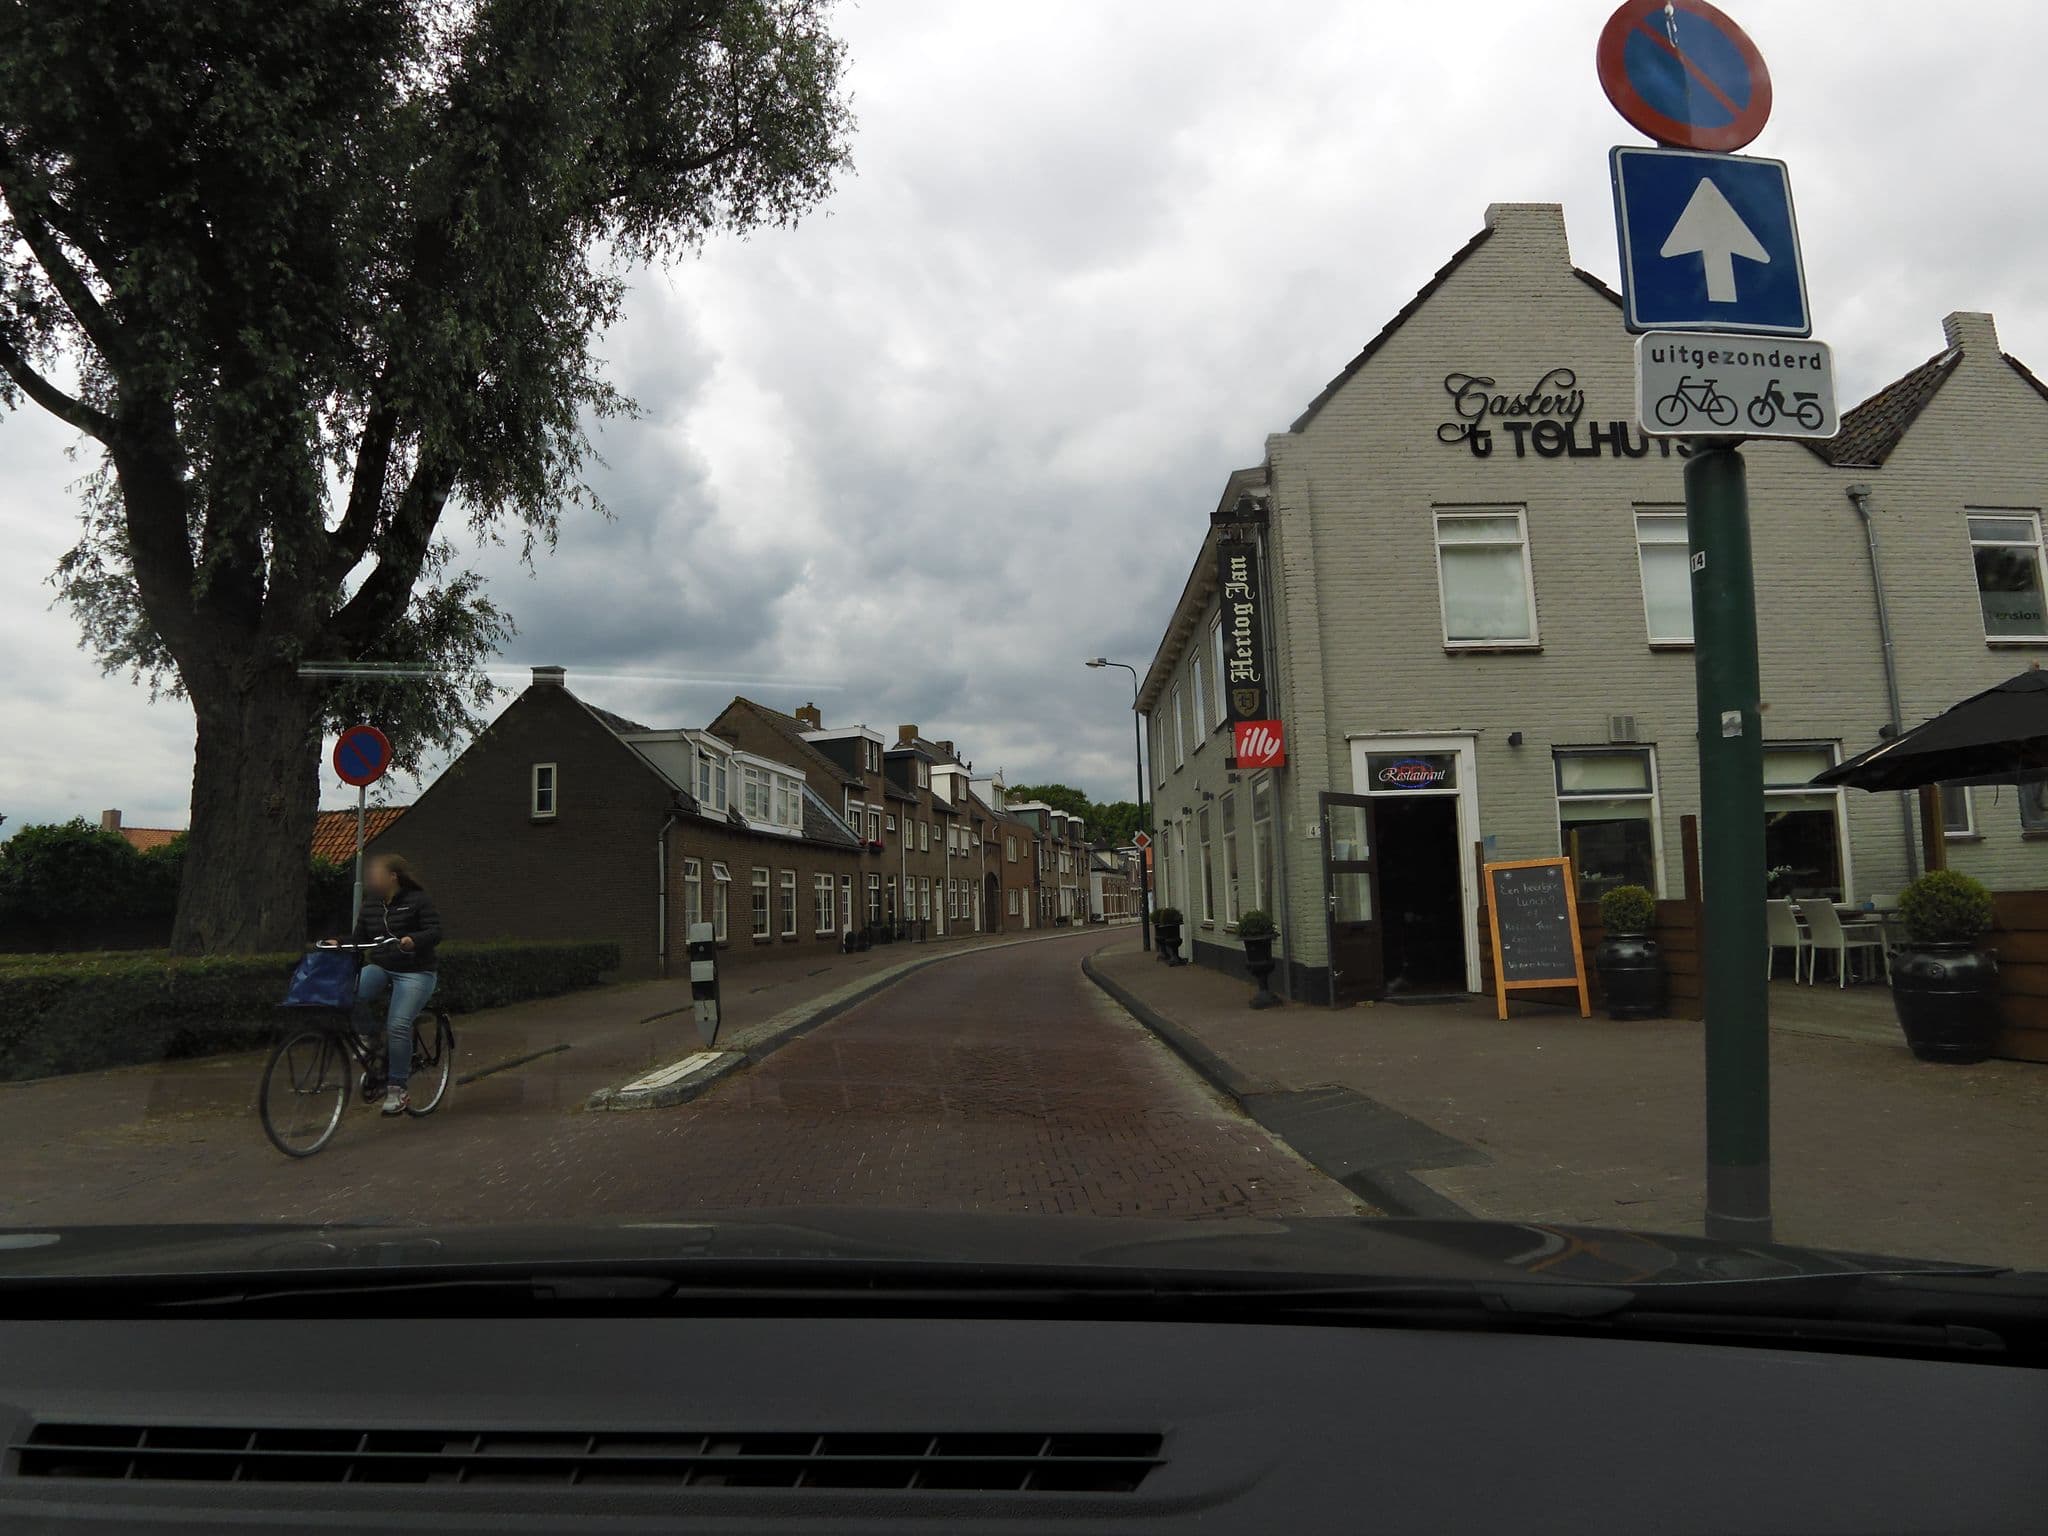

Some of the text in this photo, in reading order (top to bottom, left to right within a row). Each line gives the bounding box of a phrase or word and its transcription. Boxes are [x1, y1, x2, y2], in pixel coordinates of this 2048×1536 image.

[1651, 345, 1822, 371] uitgezonderd
[1443, 367, 1585, 427] Gasterij
[1225, 554, 1261, 683] Hertog Jan
[1240, 726, 1281, 764] illy
[1378, 767, 1446, 782] Restaurant
